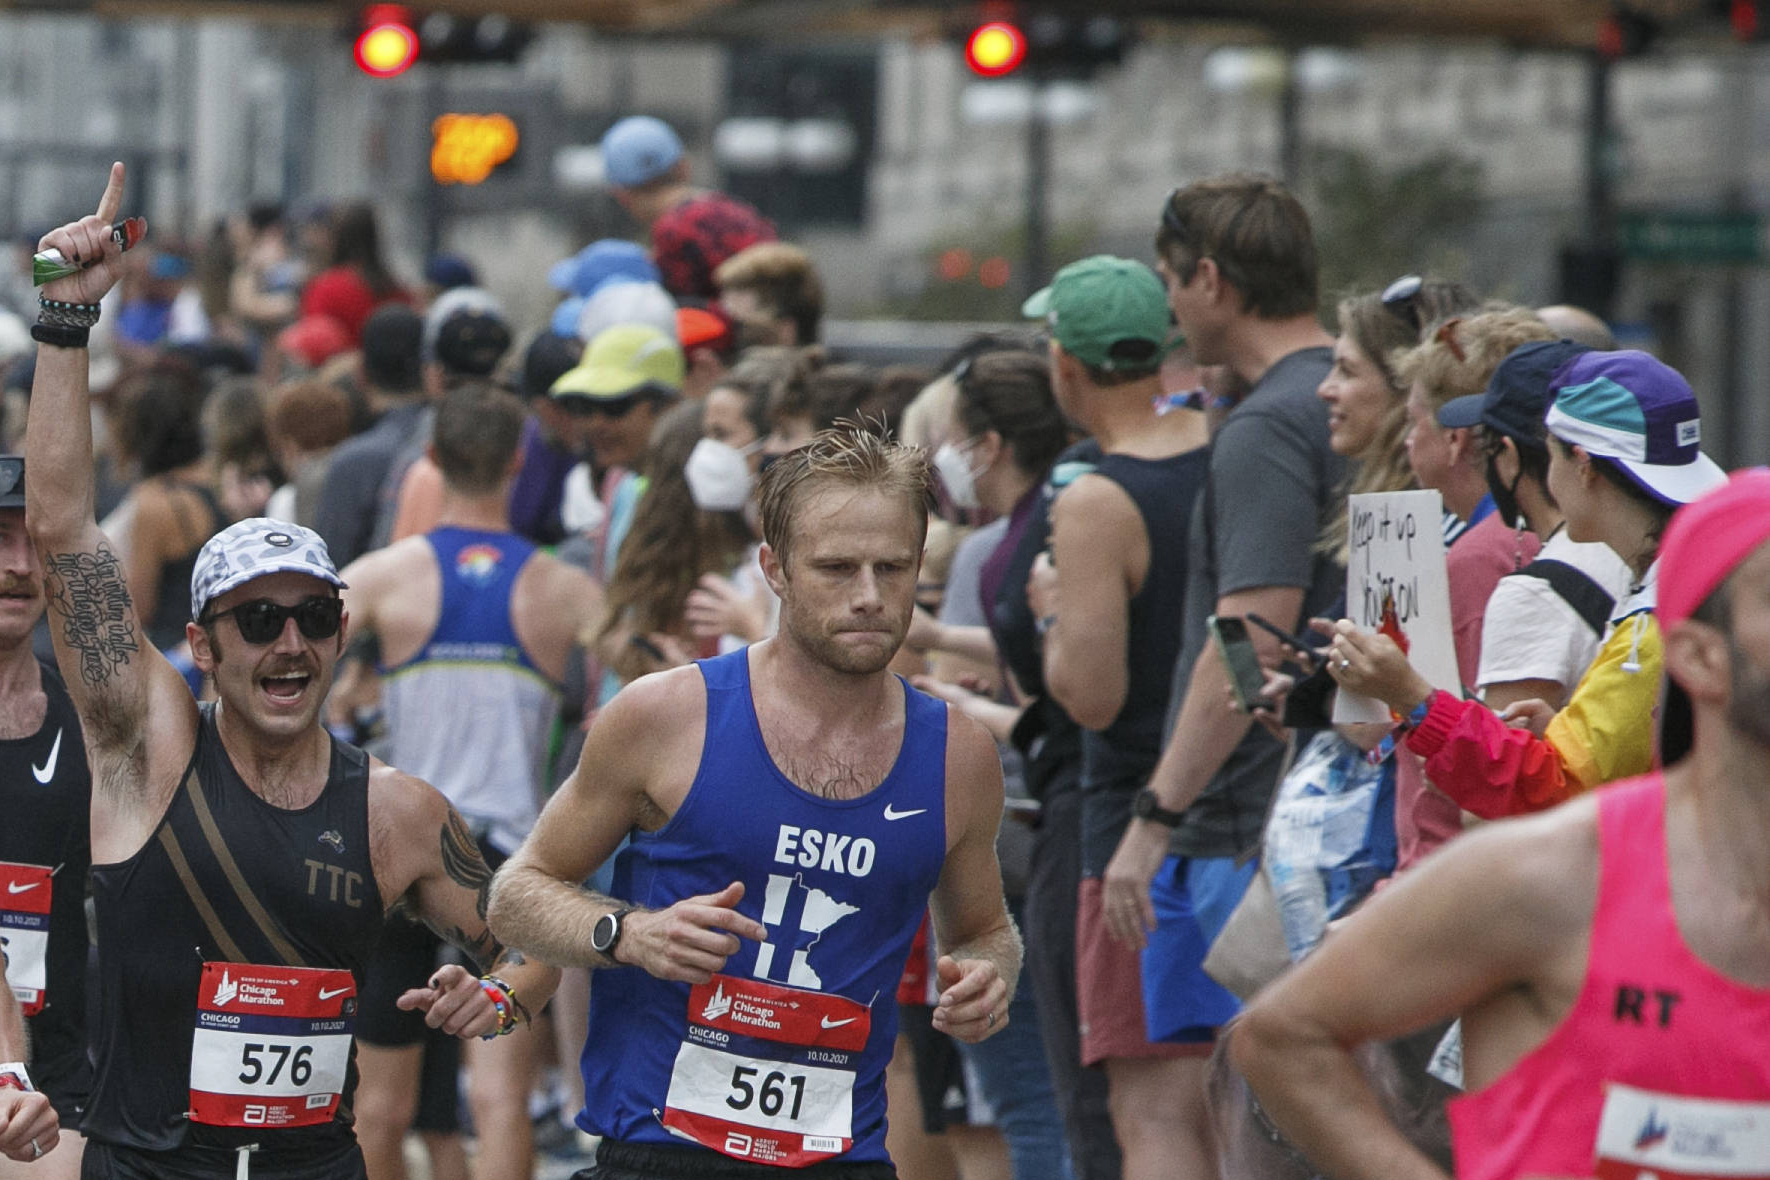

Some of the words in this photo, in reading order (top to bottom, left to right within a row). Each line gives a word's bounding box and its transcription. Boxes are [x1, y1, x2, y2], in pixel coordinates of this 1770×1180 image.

[773, 823, 876, 878] ESKO
[304, 858, 363, 909] TTC
[238, 994, 284, 1005] Marathon
[239, 984, 277, 997] Chicago
[733, 1000, 774, 1018] Chicago
[1613, 983, 1682, 1028] RT
[200, 1012, 240, 1024] CHICAGO
[731, 1010, 781, 1029] Marathon
[689, 1025, 730, 1043] CHICAGO
[238, 1042, 314, 1087] 576
[807, 1051, 849, 1065] 10.10.2021
[725, 1065, 807, 1120] 561
